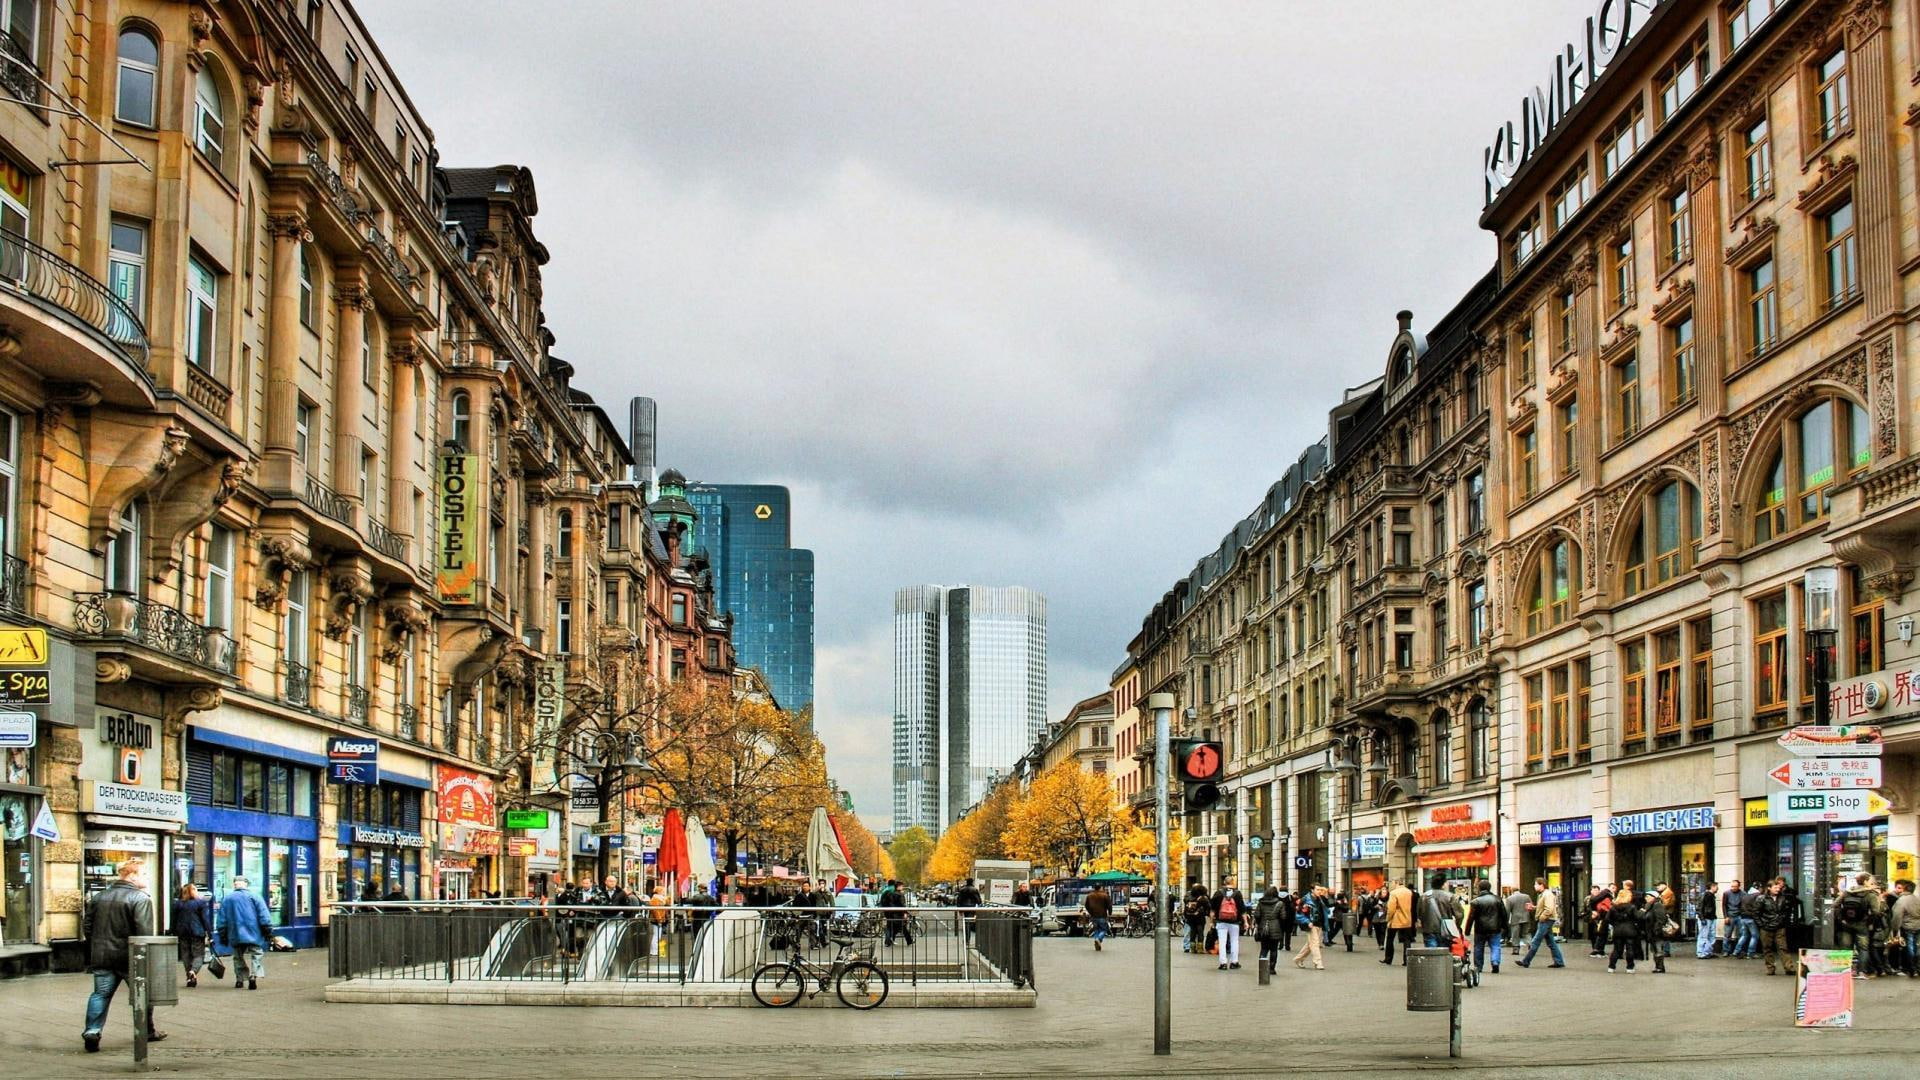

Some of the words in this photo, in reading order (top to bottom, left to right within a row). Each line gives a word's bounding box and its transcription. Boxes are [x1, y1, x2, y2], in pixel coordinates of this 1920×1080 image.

[443, 456, 466, 571] HOSTEL
[10, 672, 48, 696] Spa
[106, 714, 152, 749] BRAUN
[333, 741, 376, 754] Naspa
[99, 785, 115, 798] DER
[116, 788, 182, 805] TROCKENRASIERER
[1791, 797, 1823, 808] BASE
[1828, 796, 1860, 809] Shop
[1608, 807, 1715, 836] SCHLECKER
[1750, 808, 1768, 819] Intern
[355, 826, 395, 845] Nassauische
[396, 831, 425, 848] Sparkasse
[1546, 824, 1570, 834] Mobile
[1572, 822, 1591, 832] Hous
[1365, 837, 1384, 846] back
